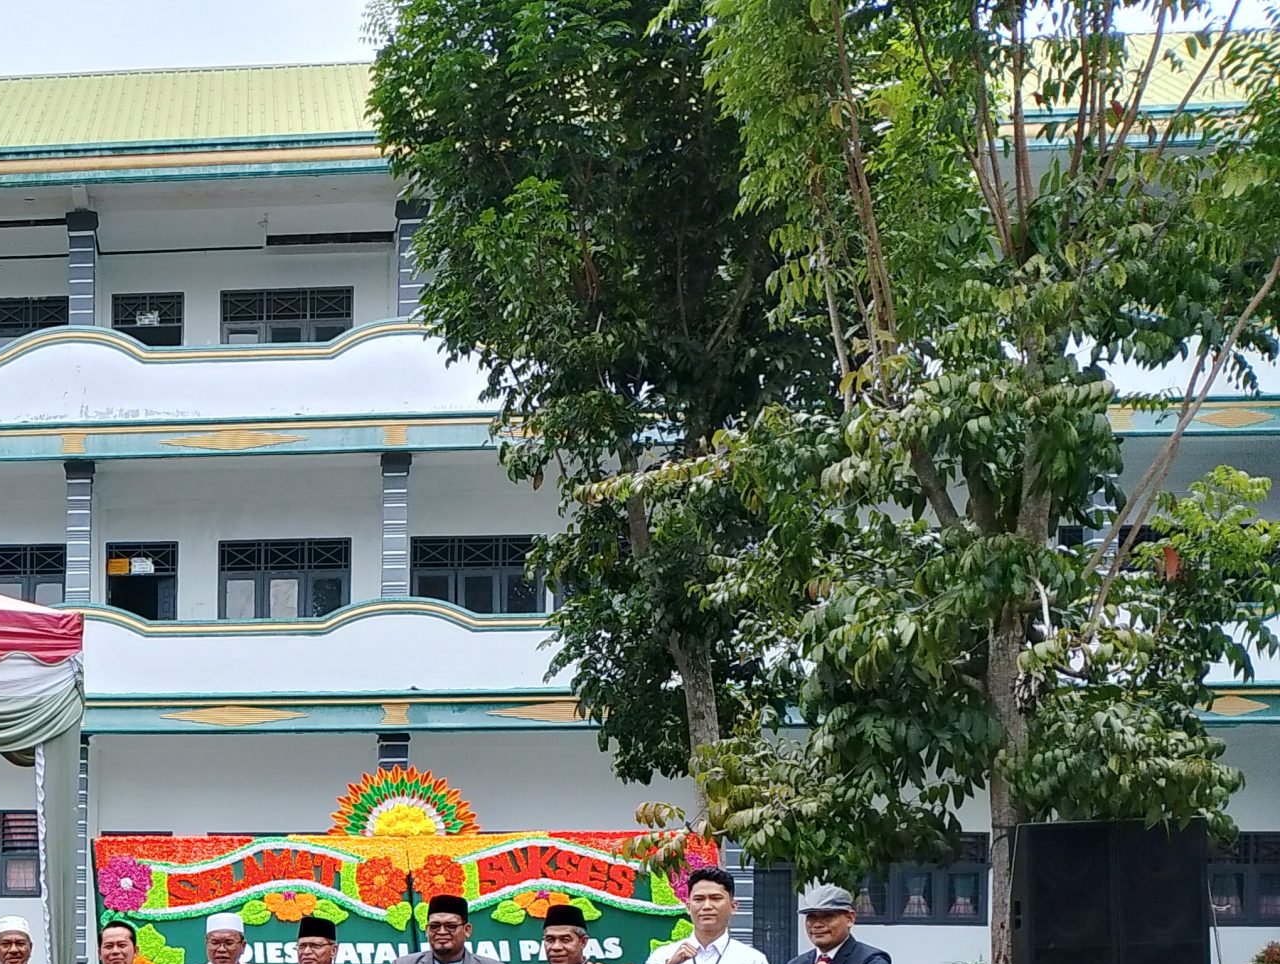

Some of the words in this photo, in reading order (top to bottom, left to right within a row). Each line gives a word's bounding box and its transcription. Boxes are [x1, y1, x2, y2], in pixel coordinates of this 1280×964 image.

[167, 847, 342, 907] SELAMAT
[477, 845, 635, 899] SUKSES
[239, 941, 299, 964] DIES
